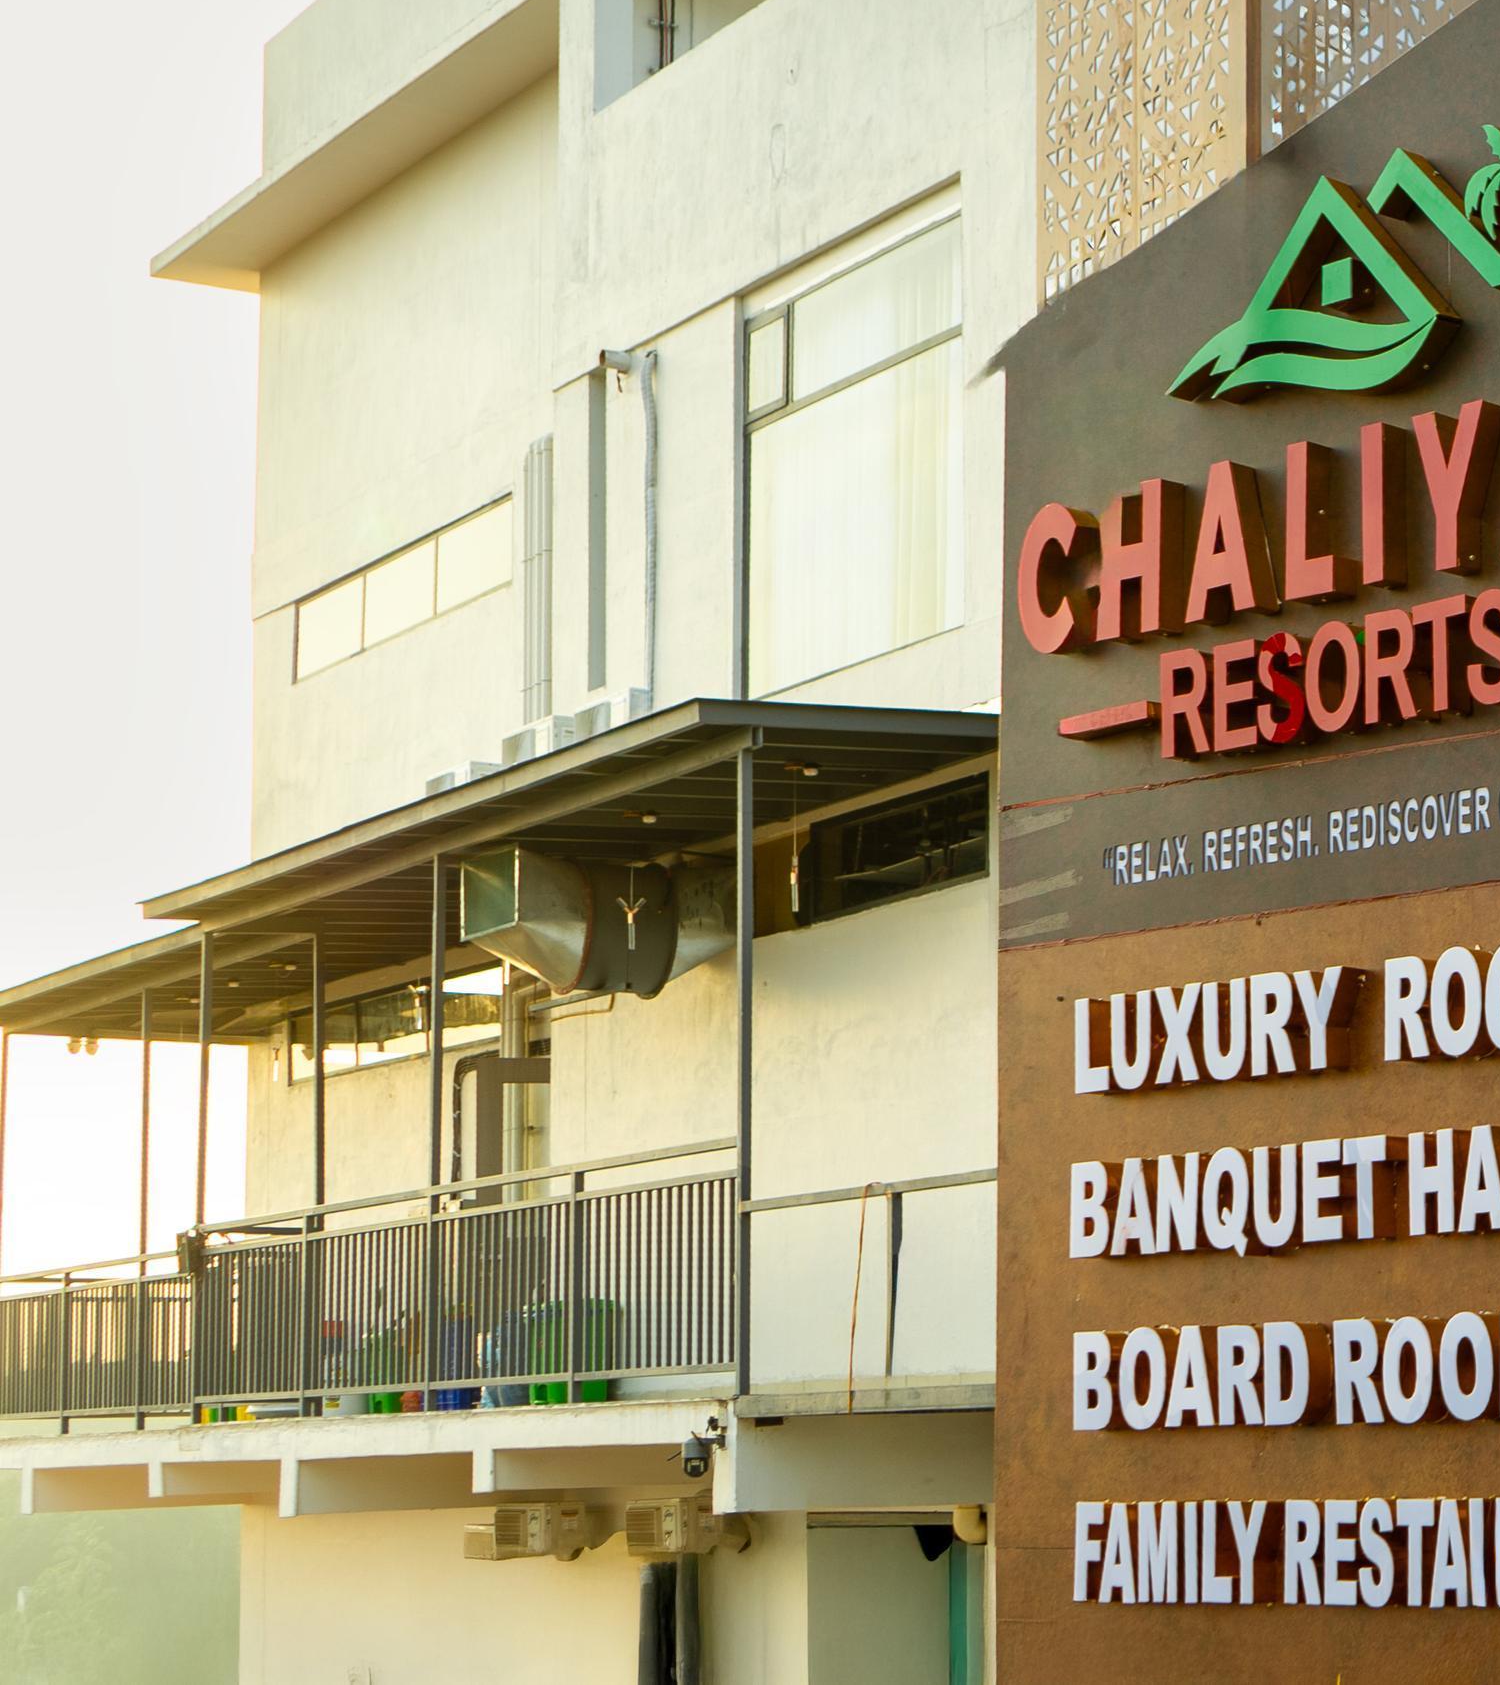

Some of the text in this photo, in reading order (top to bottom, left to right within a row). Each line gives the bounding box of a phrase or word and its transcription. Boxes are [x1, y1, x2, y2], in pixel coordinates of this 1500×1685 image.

[1203, 817, 1318, 872] REFRESH.
[1329, 788, 1491, 853] REDISCOVER
[1074, 966, 1344, 1094] LUXURY
[1069, 1134, 1386, 1258] BANQUET
[1073, 1321, 1310, 1431] BOARD
[1073, 1500, 1268, 1605] FAMILY
